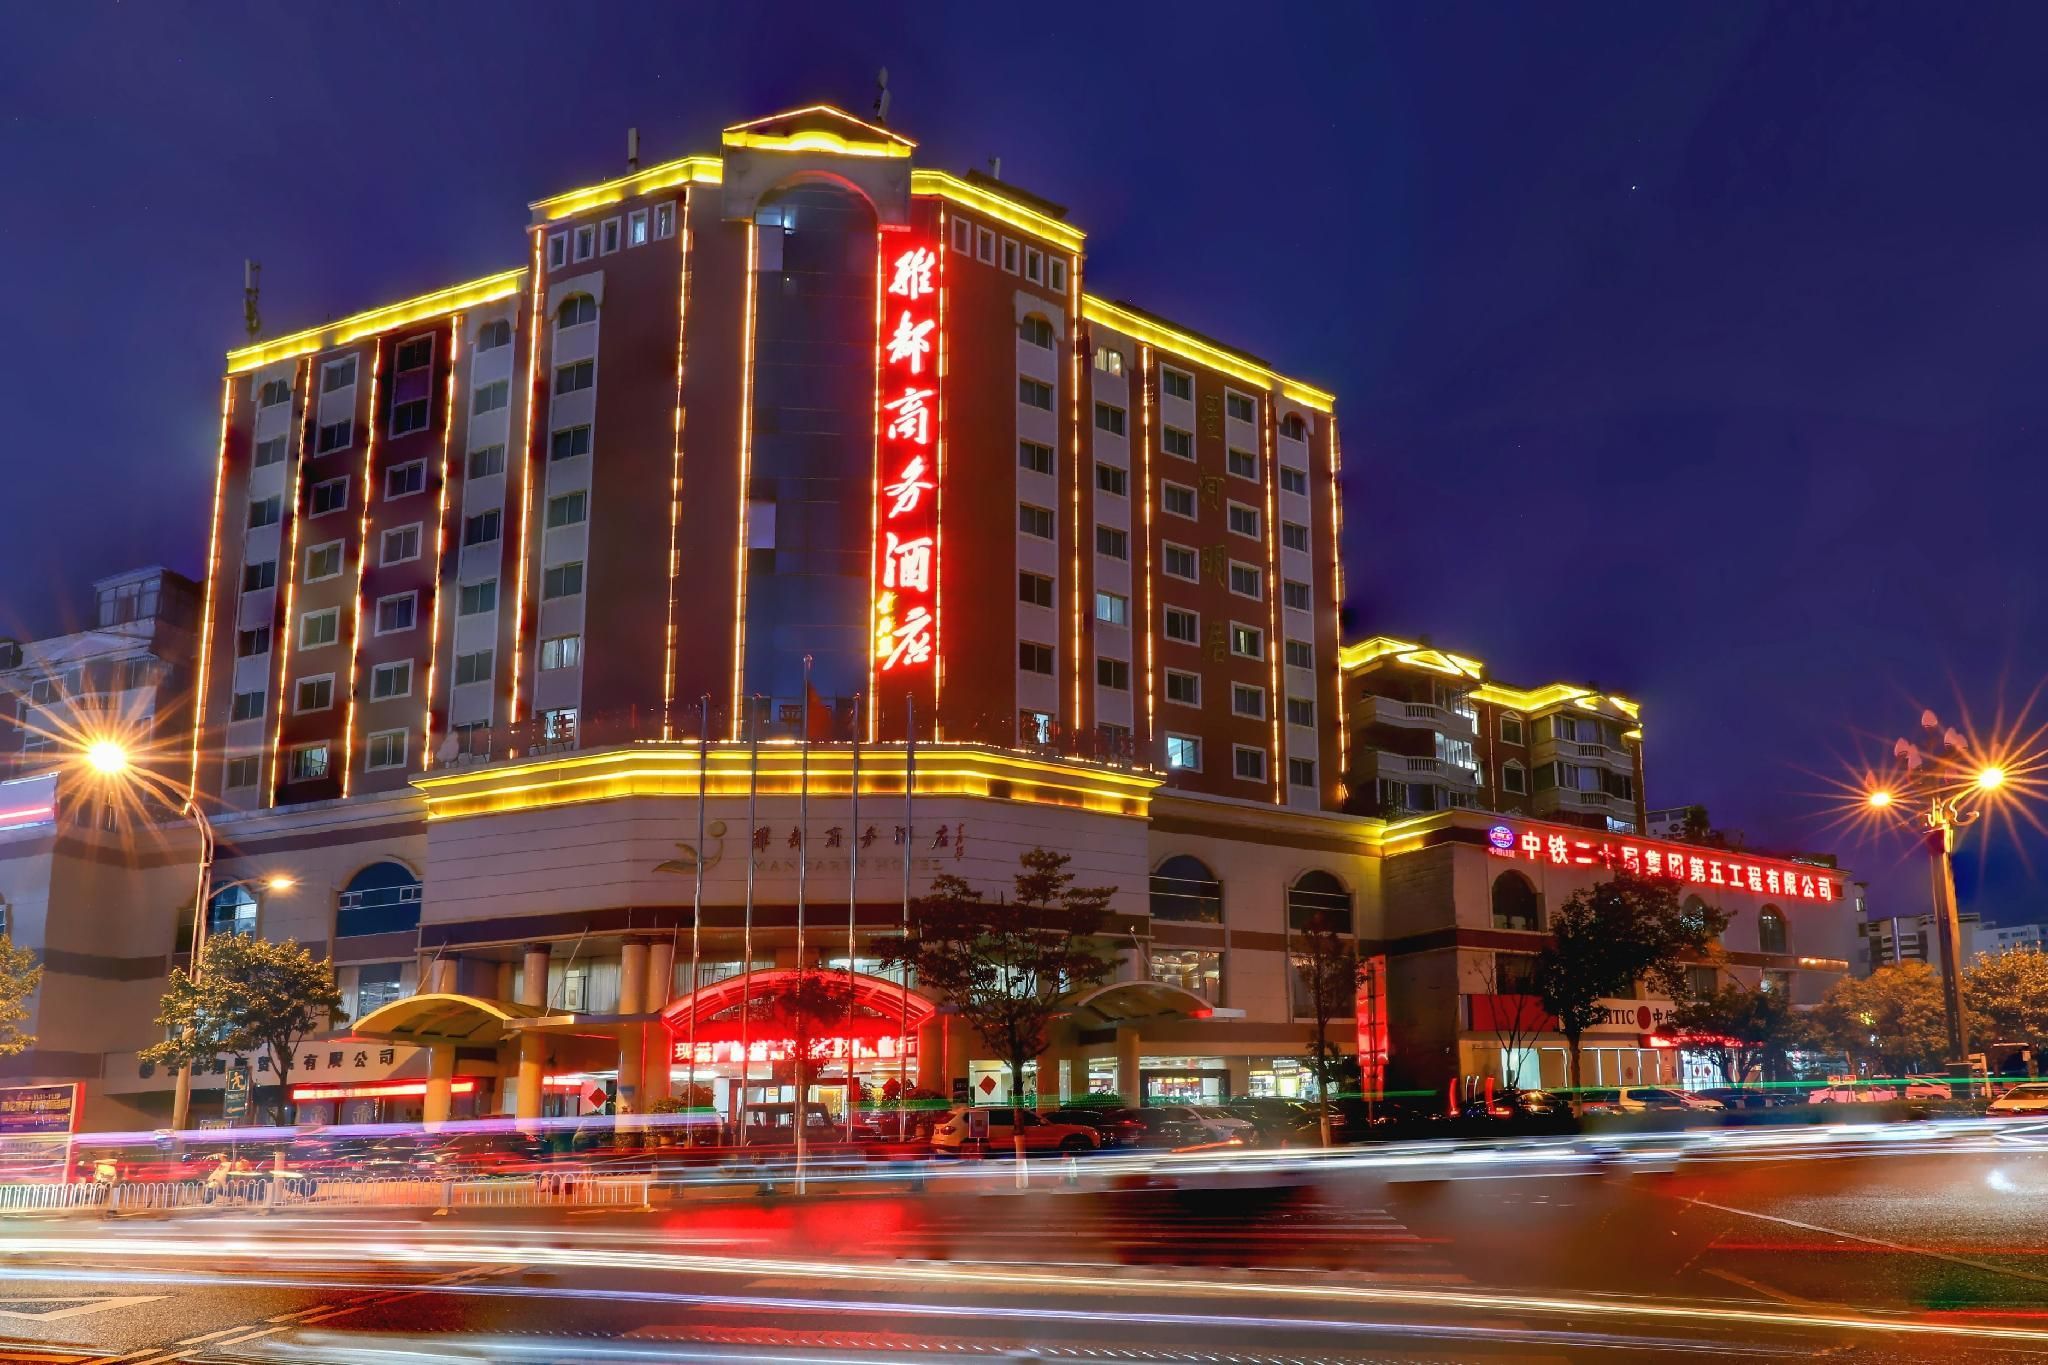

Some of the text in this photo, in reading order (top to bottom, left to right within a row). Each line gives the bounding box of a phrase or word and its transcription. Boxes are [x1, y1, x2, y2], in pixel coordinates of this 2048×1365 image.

[882, 246, 938, 671] 雅都商务酒店
[1521, 831, 1833, 902] 中铁二十局集团第五工程有限公司
